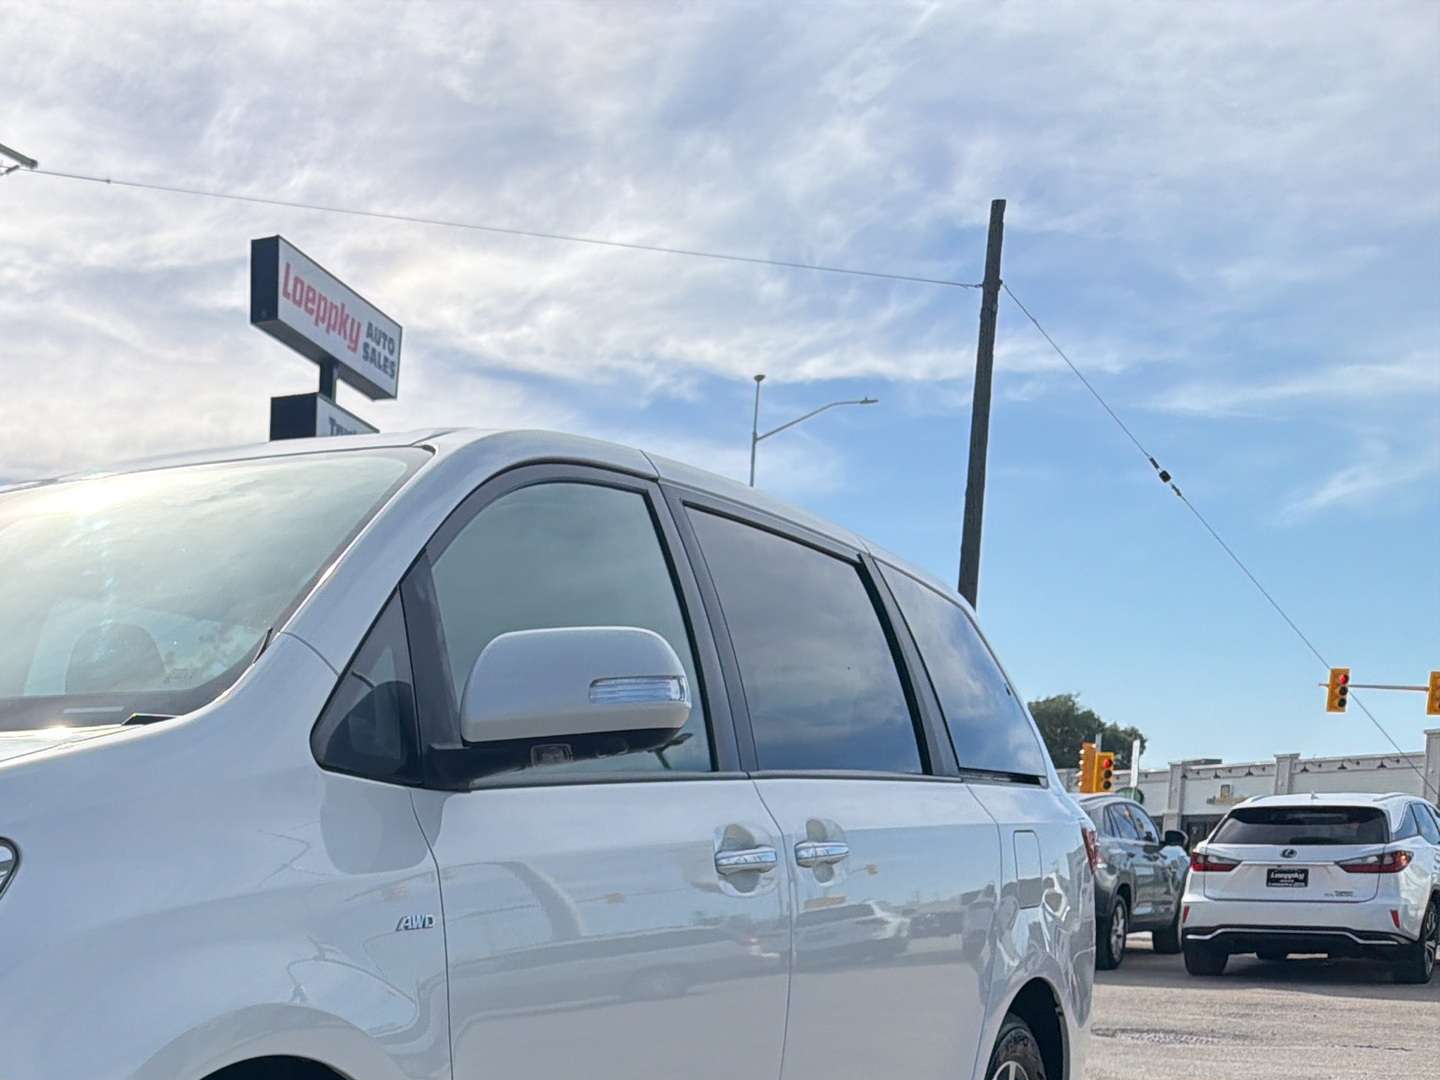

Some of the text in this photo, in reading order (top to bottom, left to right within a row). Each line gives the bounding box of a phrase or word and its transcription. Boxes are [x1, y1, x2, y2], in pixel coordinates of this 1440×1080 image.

[282, 262, 361, 352] Loeppky
[366, 322, 395, 356] AUTO
[362, 343, 396, 379] SALES
[396, 914, 436, 931] AWD
